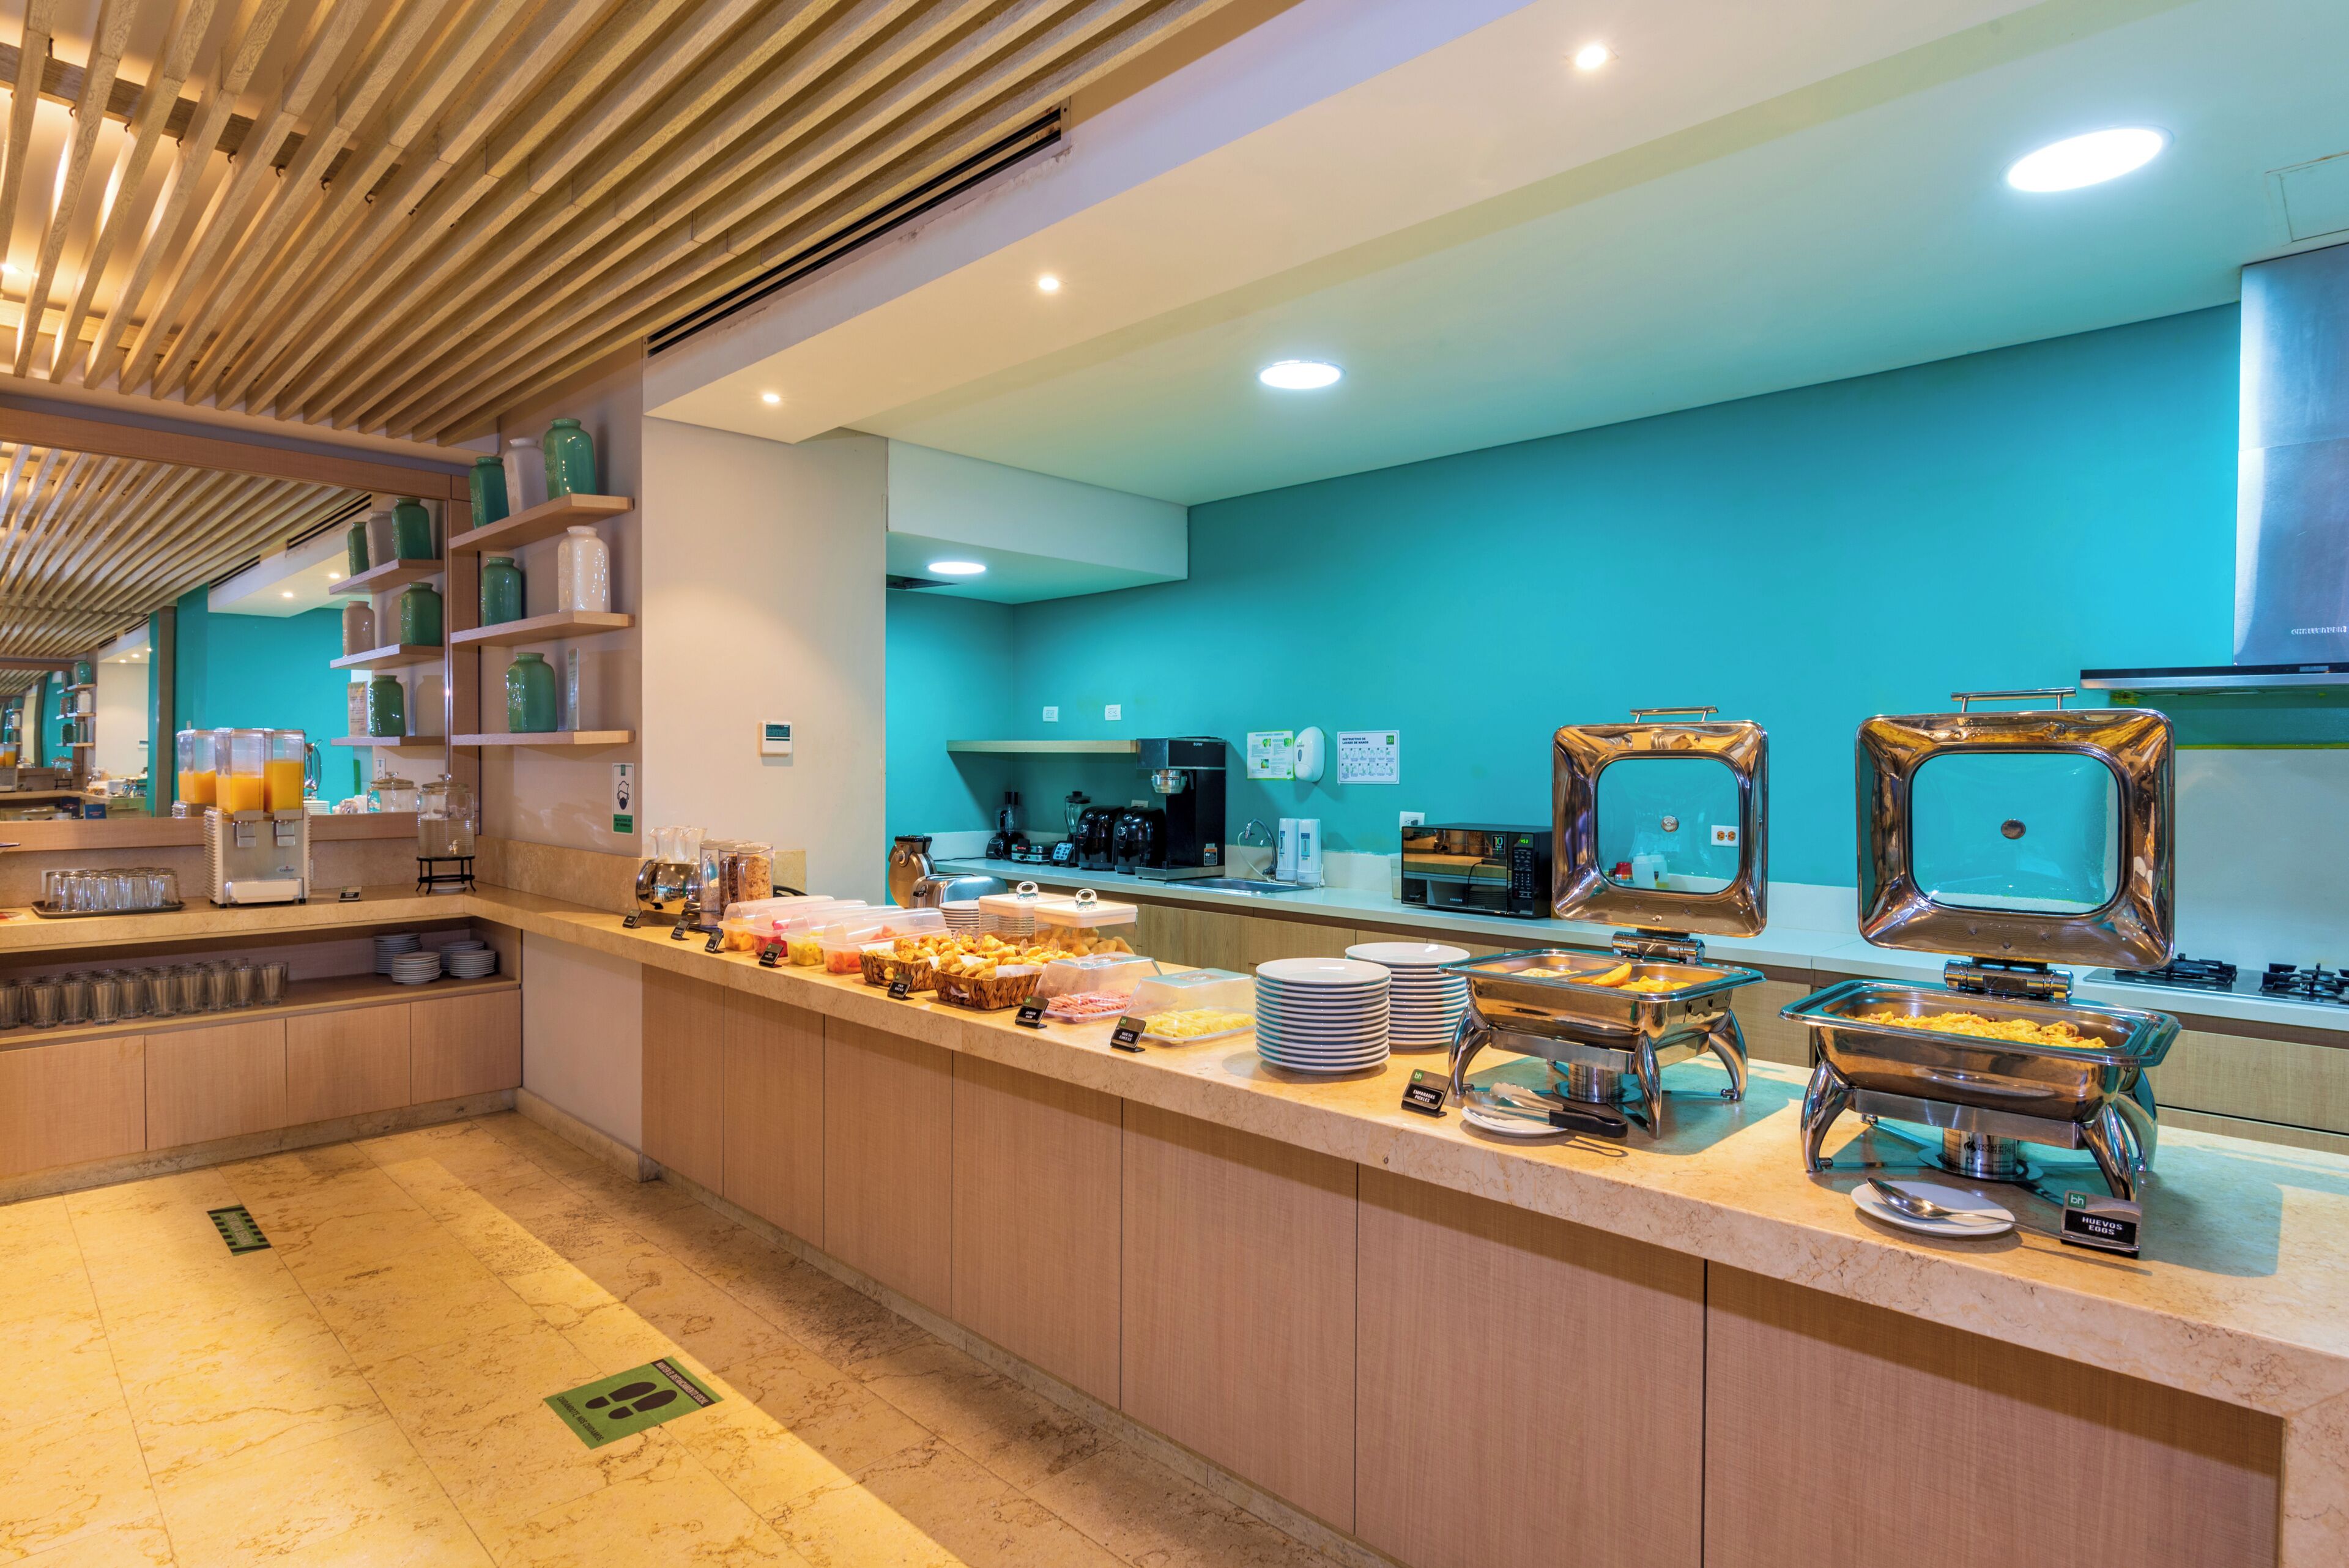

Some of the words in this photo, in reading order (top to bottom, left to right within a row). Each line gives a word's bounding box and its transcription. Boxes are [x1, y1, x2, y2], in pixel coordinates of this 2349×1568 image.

[1493, 836, 1503, 845] 10
[1412, 1089, 1436, 1100] EMPANADAS
[2070, 1194, 2084, 1206] bh
[2082, 1216, 2123, 1231] HUEVOS
[2088, 1225, 2115, 1236] EGGS
[575, 1414, 588, 1424] NOS
